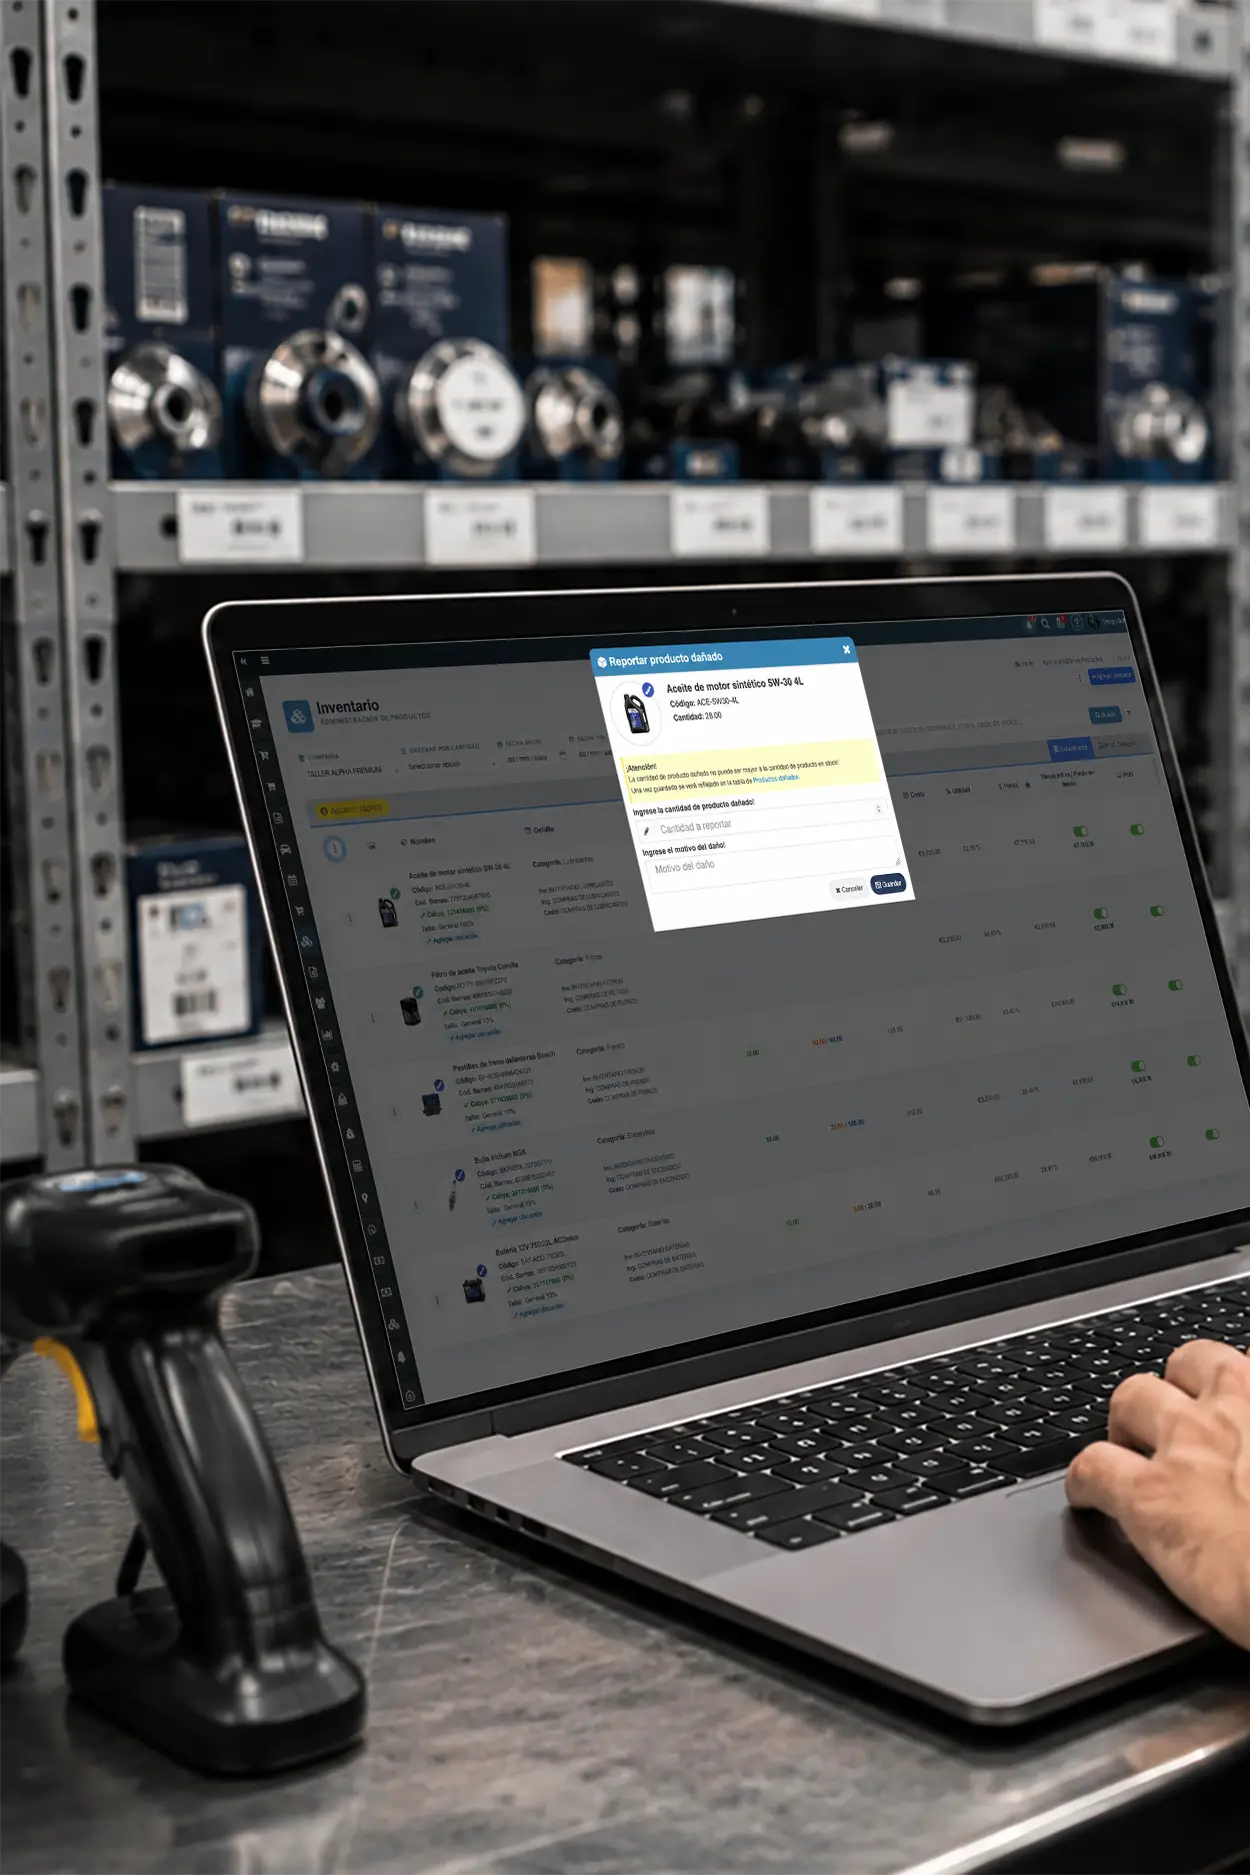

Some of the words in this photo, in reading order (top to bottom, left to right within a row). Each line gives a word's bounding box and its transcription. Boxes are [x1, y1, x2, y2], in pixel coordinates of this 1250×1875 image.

[608, 656, 648, 667] Reportar
[649, 653, 689, 665] producto
[690, 651, 723, 663] dañado
[666, 683, 692, 692] Aceite
[694, 682, 704, 691] de
[706, 682, 730, 690] motor
[732, 679, 766, 689] sintético
[767, 677, 792, 687] 5W-30
[794, 676, 803, 685] 4L
[316, 699, 380, 713] Inventario
[669, 699, 695, 708] Código:
[390, 712, 431, 720] PRODUCTOS
[673, 713, 704, 721] Cantidad:
[704, 711, 722, 719] 28.00
[408, 761, 441, 771] Seleccionar
[306, 769, 332, 777] TALLER
[636, 774, 658, 782] cantidad
[796, 761, 817, 769] producto
[653, 784, 678, 793] guardado
[632, 808, 656, 816] Ingrese
[664, 804, 691, 812] cantidad
[701, 801, 729, 810] producto
[533, 825, 554, 833] Detalle
[660, 822, 694, 834] Cantidad
[695, 822, 701, 830] a
[702, 819, 732, 830] reportar
[409, 837, 435, 845] Nombre
[642, 848, 666, 857] Ingrese
[667, 846, 673, 854] el
[674, 845, 696, 853] motivo
[562, 856, 594, 864] Lubricantes
[654, 863, 681, 873] Motivo
[682, 861, 694, 870] del
[695, 859, 714, 869] daño
[409, 871, 427, 879] Aceite
[457, 866, 482, 874] sintético
[476, 965, 496, 973] Toyota
[497, 961, 518, 969] Corolla
[452, 1063, 478, 1071] Pastillas
[505, 1054, 536, 1063] delanteras
[536, 1050, 555, 1059] Bosch
[455, 1076, 476, 1084] Código:
[512, 1148, 526, 1157] NGK
[498, 1261, 519, 1270] Código:
